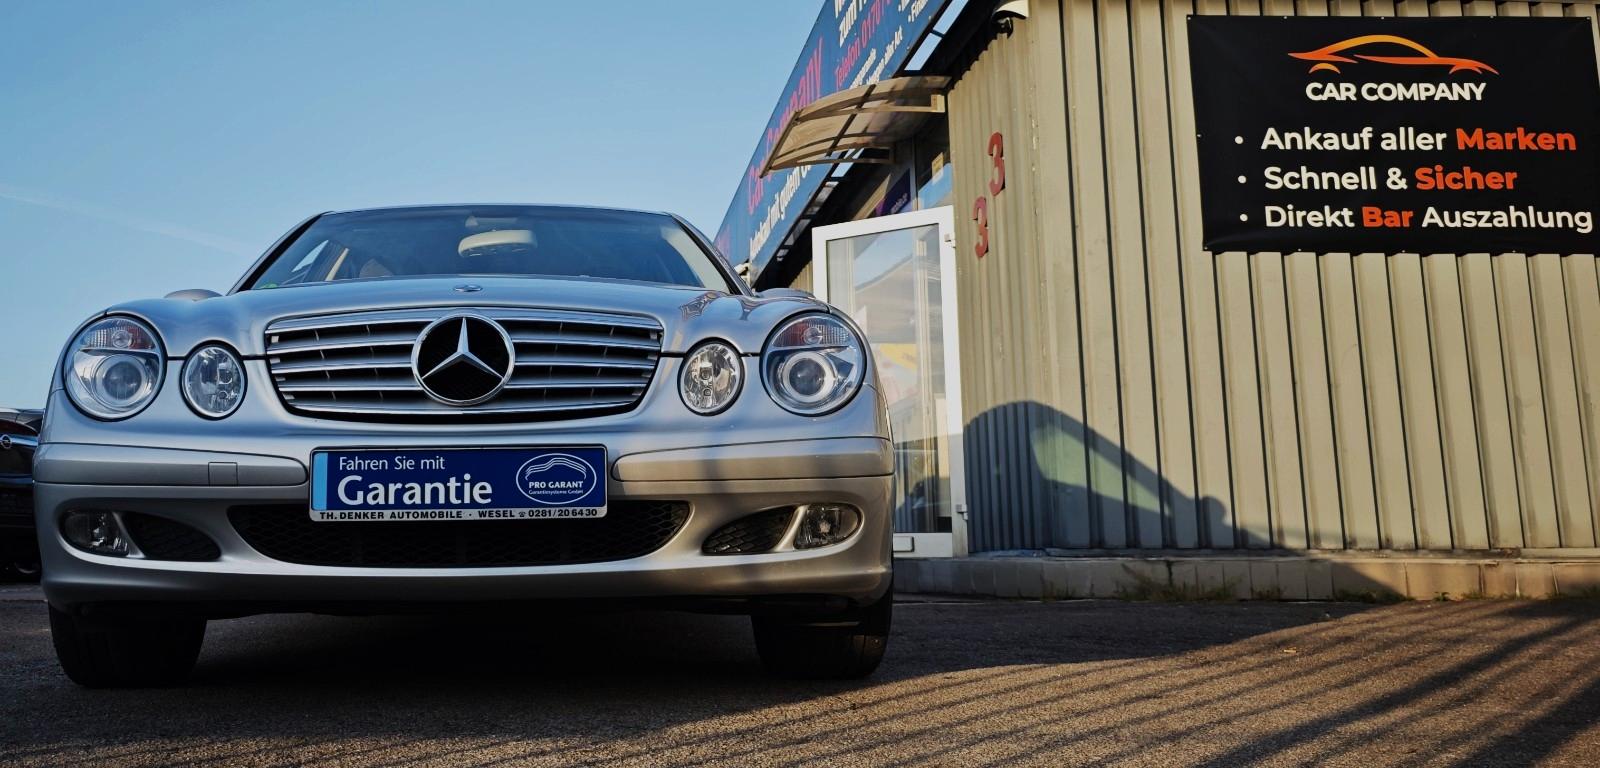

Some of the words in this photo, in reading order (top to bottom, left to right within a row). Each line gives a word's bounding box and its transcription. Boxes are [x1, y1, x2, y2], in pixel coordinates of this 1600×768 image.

[1306, 82, 1357, 101] CAR
[1361, 82, 1486, 101] COMPANY
[1261, 127, 1373, 151] Ankauf
[1380, 127, 1447, 151] aller
[1456, 127, 1577, 151] Marken
[1264, 166, 1377, 190] Schnell
[1386, 167, 1408, 190] &
[1415, 165, 1518, 190] Sicher
[1264, 204, 1355, 228] Direkt
[1362, 206, 1413, 228] Bar
[1422, 205, 1593, 234] Auszahlung
[339, 456, 388, 471] Fahren
[394, 456, 416, 471] Sie
[420, 456, 445, 470] mit
[337, 473, 493, 506] Garantie
[528, 481, 546, 489] PRO
[548, 481, 584, 489] GARANT
[390, 510, 463, 520] AUTOMOBILE
[478, 509, 515, 518] WESEL
